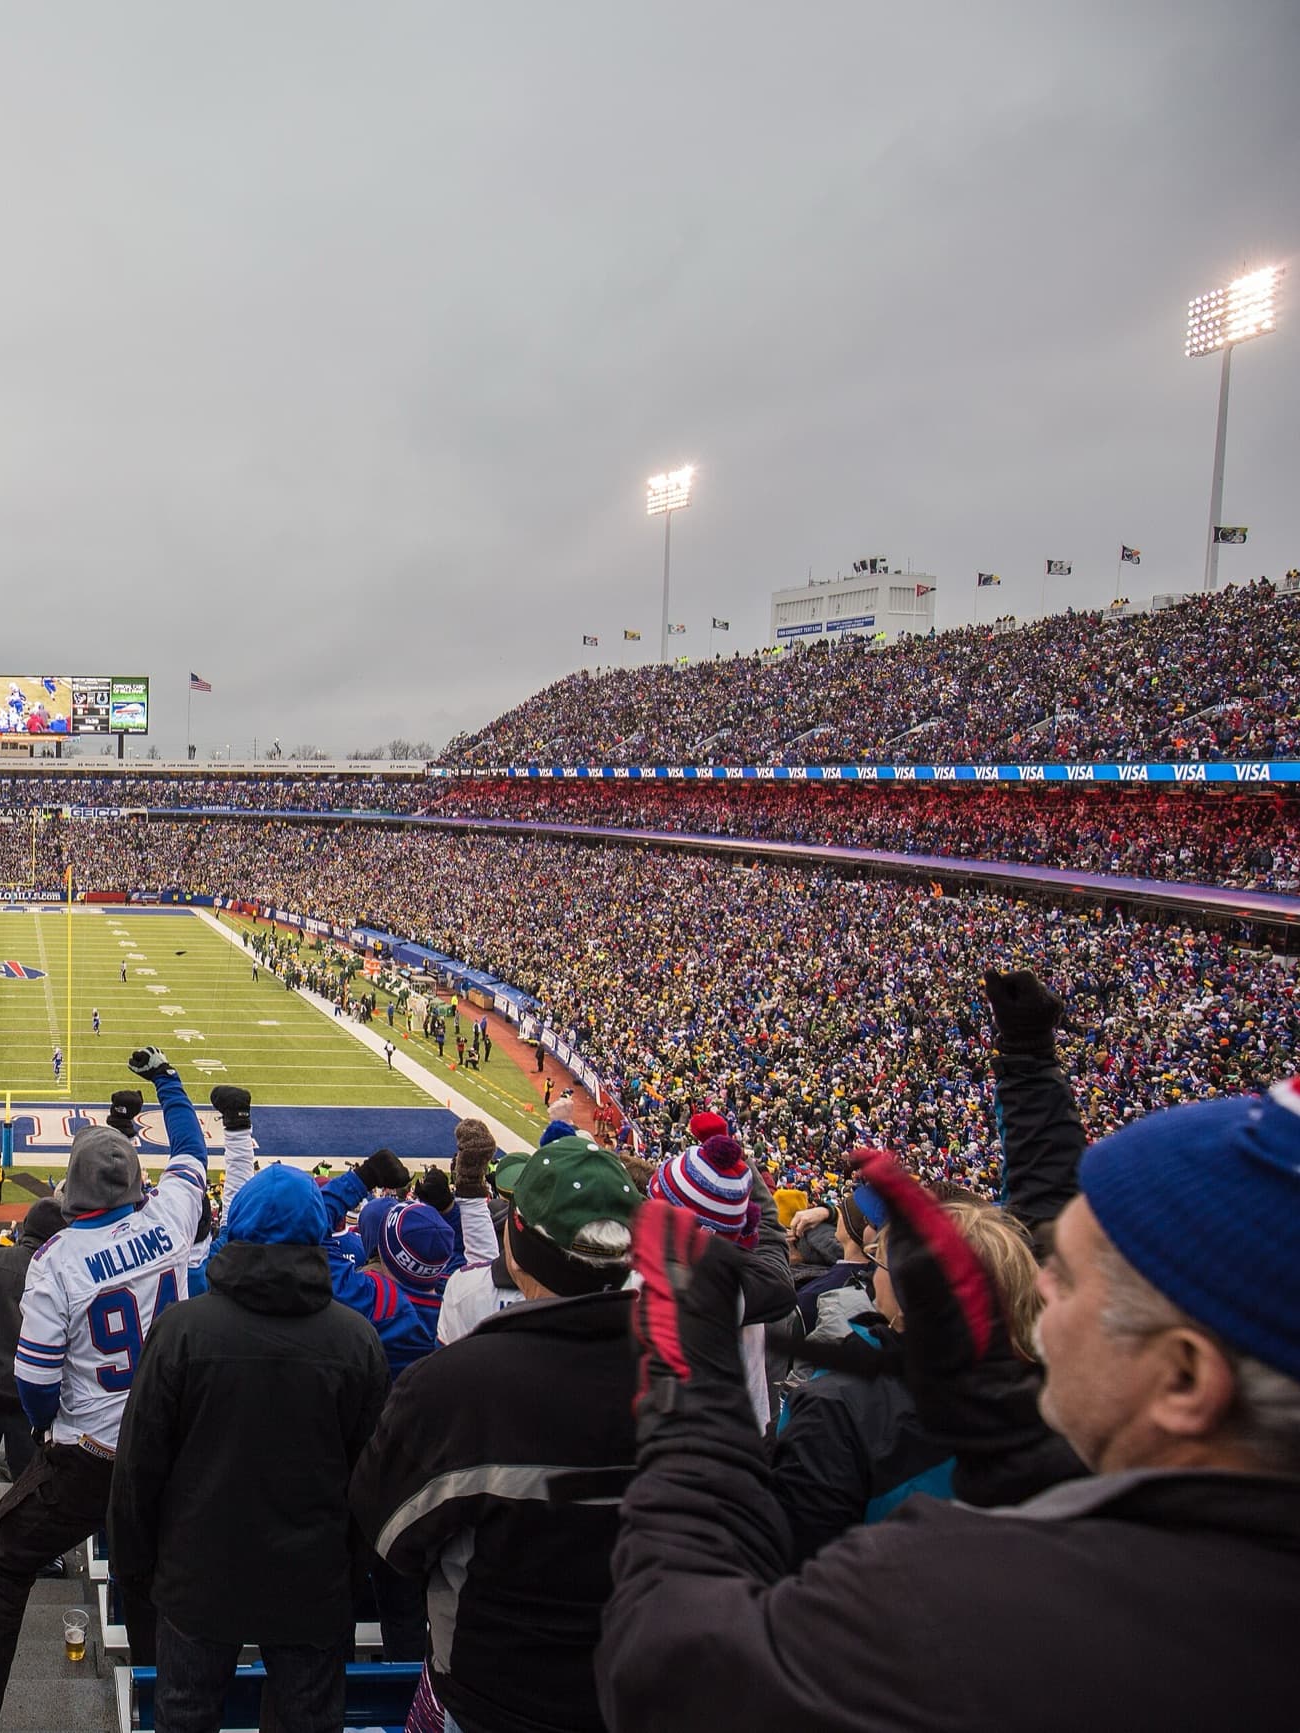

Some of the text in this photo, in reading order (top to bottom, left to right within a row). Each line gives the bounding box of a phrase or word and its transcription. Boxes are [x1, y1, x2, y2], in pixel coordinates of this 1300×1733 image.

[538, 769, 553, 777] VISA
[562, 768, 578, 777] VISA
[587, 768, 604, 777] VISA
[613, 768, 630, 777] VISA
[639, 768, 656, 777] VISA
[667, 768, 684, 777] VISA
[695, 768, 714, 778] VISA
[725, 768, 744, 778] VISA
[755, 768, 775, 778] VISA
[787, 768, 807, 778] VISA
[821, 768, 842, 778] VISA
[856, 768, 878, 779] VISA
[893, 767, 916, 779] VISA
[932, 767, 956, 779] VISA
[973, 767, 999, 779] VISA
[1018, 767, 1045, 780] VISA
[1065, 766, 1094, 779] VISA
[1117, 766, 1148, 780] VISA
[1172, 765, 1206, 780] VISA
[1233, 765, 1271, 780] VISA
[7, 808, 27, 817] AND
[71, 808, 121, 818] GEICO
[84, 1225, 175, 1284] WILLIAMS
